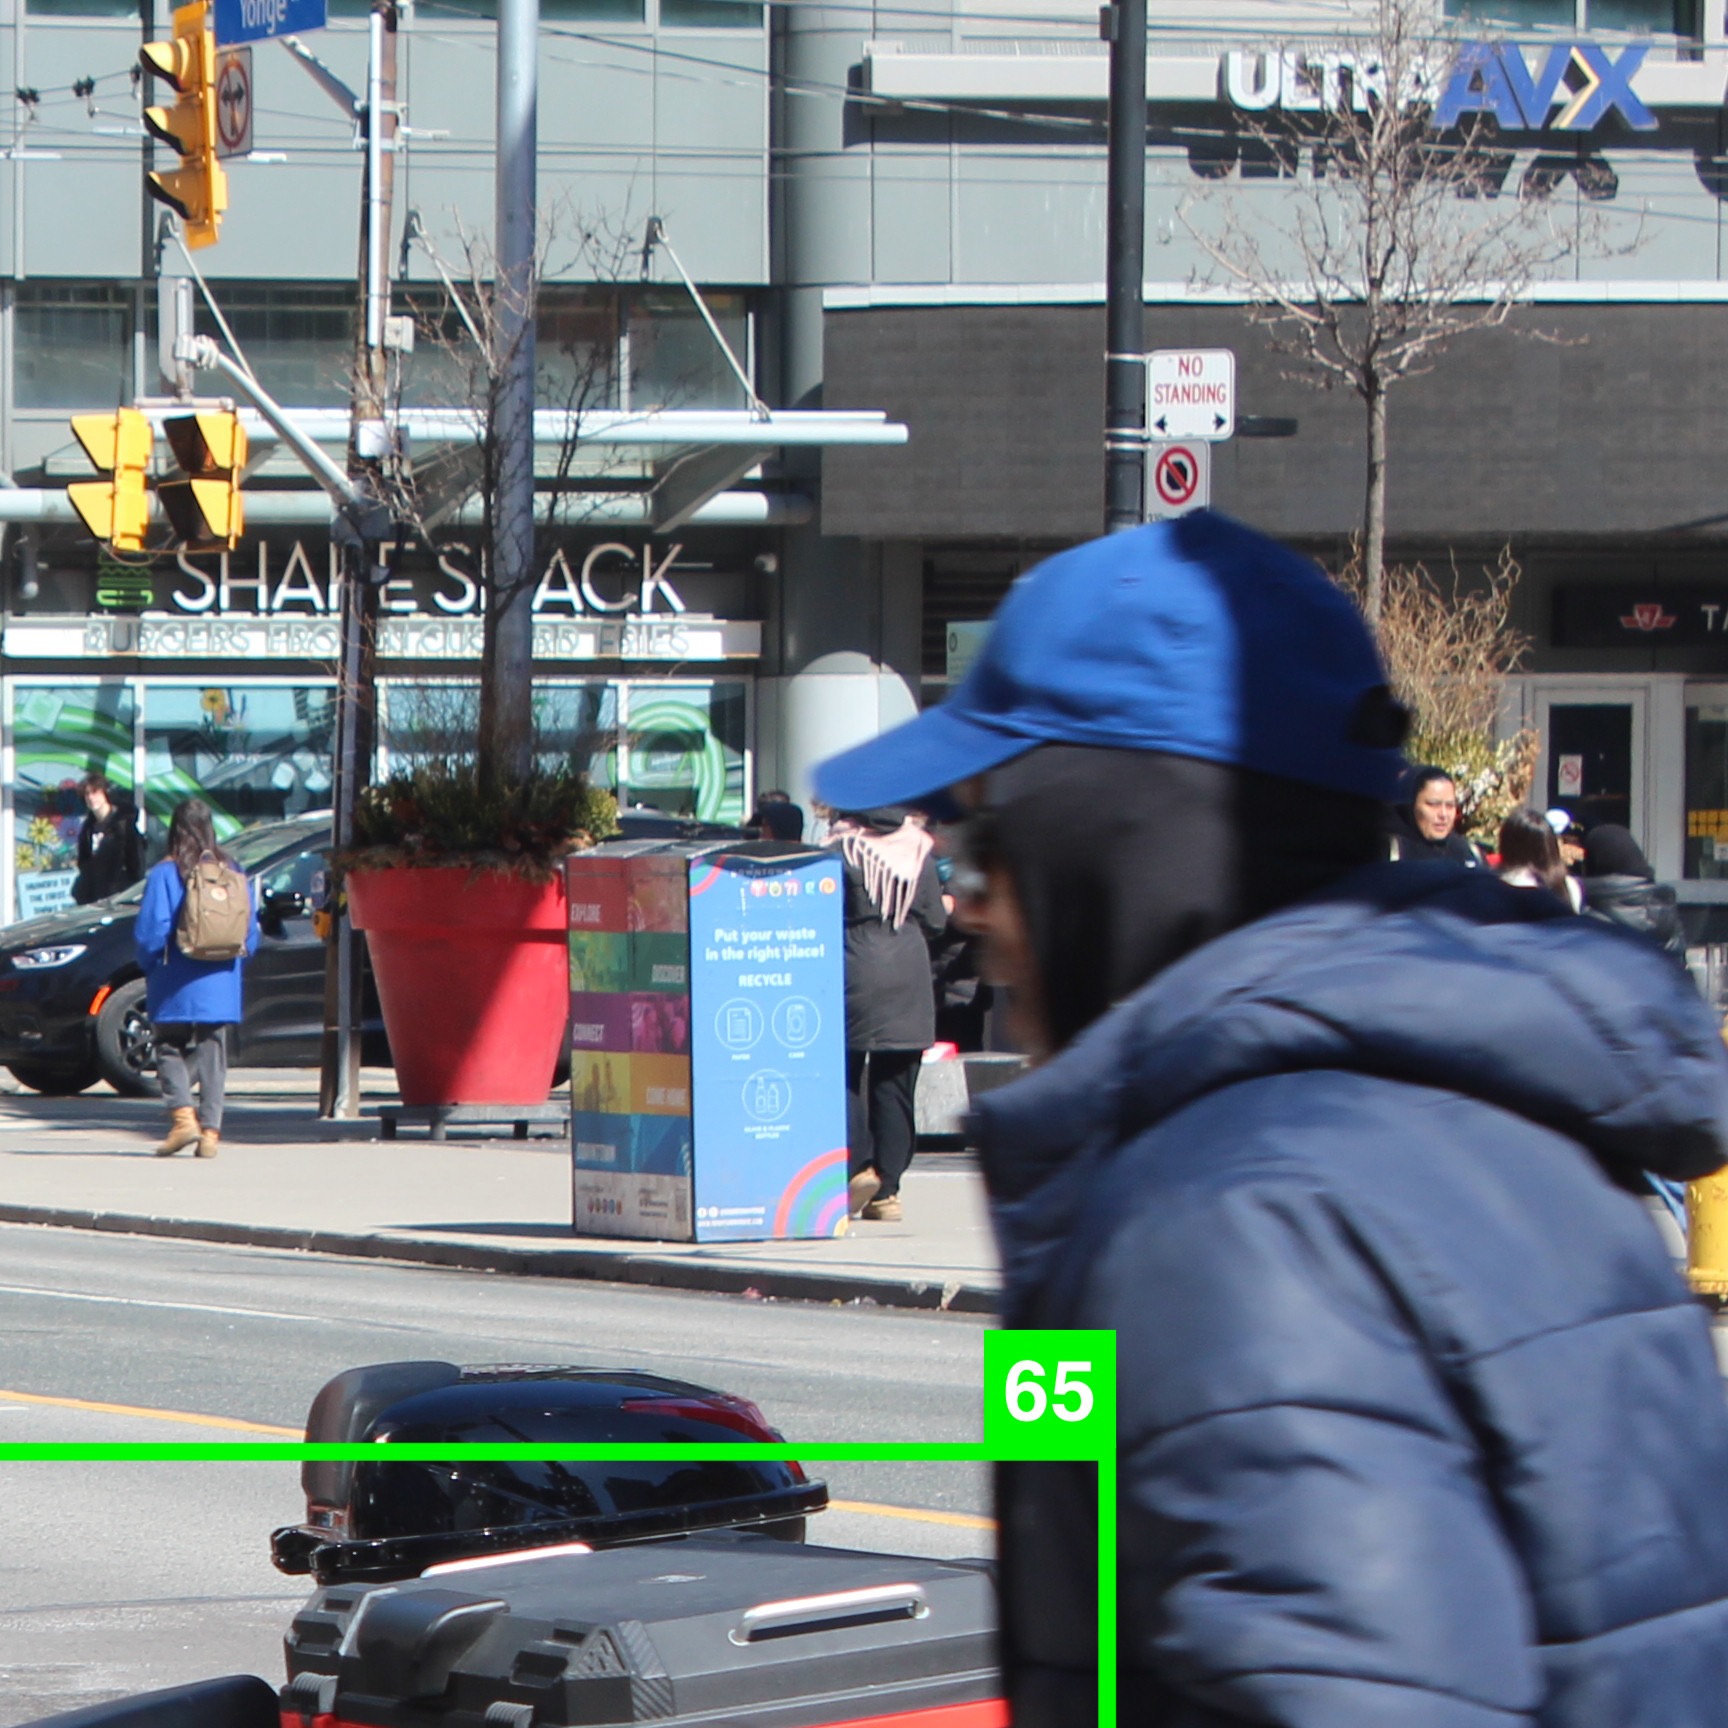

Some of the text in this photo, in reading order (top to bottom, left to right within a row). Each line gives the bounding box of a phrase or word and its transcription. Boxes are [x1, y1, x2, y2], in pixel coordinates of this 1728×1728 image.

[1429, 39, 1660, 131] AVX
[1178, 356, 1203, 377] NO
[1154, 383, 1227, 405] STANDING
[714, 928, 817, 946] Put your waste
[705, 944, 825, 964] in the right place!
[738, 972, 793, 988] RECYCLE
